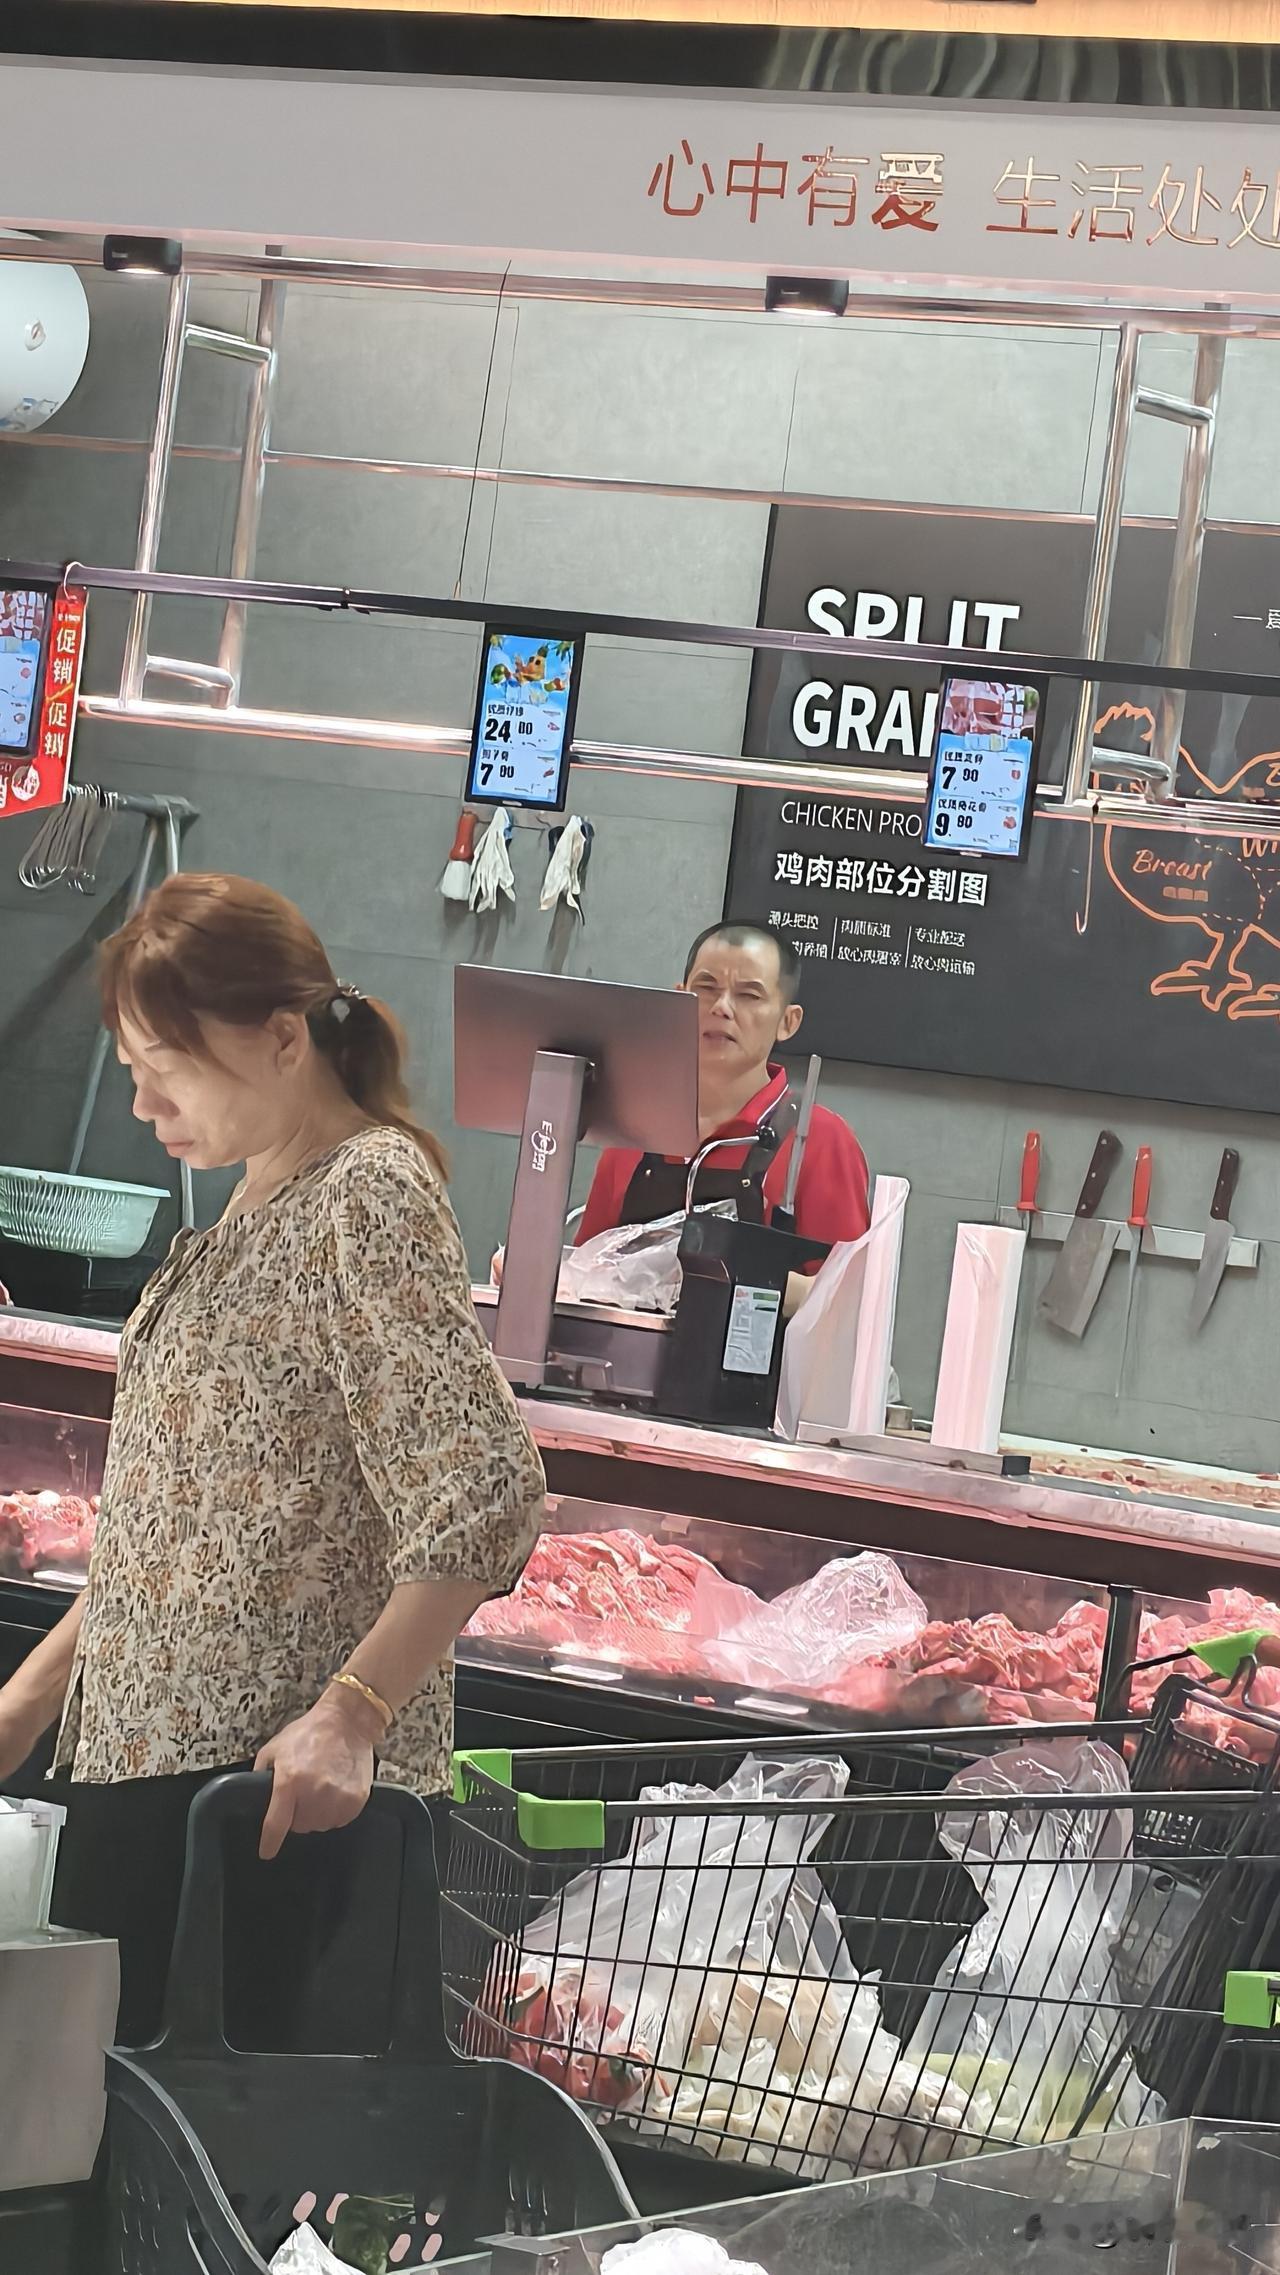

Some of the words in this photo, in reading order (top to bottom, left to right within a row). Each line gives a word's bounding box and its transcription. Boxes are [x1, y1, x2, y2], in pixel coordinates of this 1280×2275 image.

[648, 139, 943, 232] 心中有爱
[986, 156, 1280, 249] 生活处处
[807, 588, 1020, 651] SPLIT
[53, 627, 76, 684] 促销
[781, 801, 873, 832] CHICKEN
[774, 852, 988, 906] 鸡肉部位分割图
[1132, 849, 1213, 880] Breast
